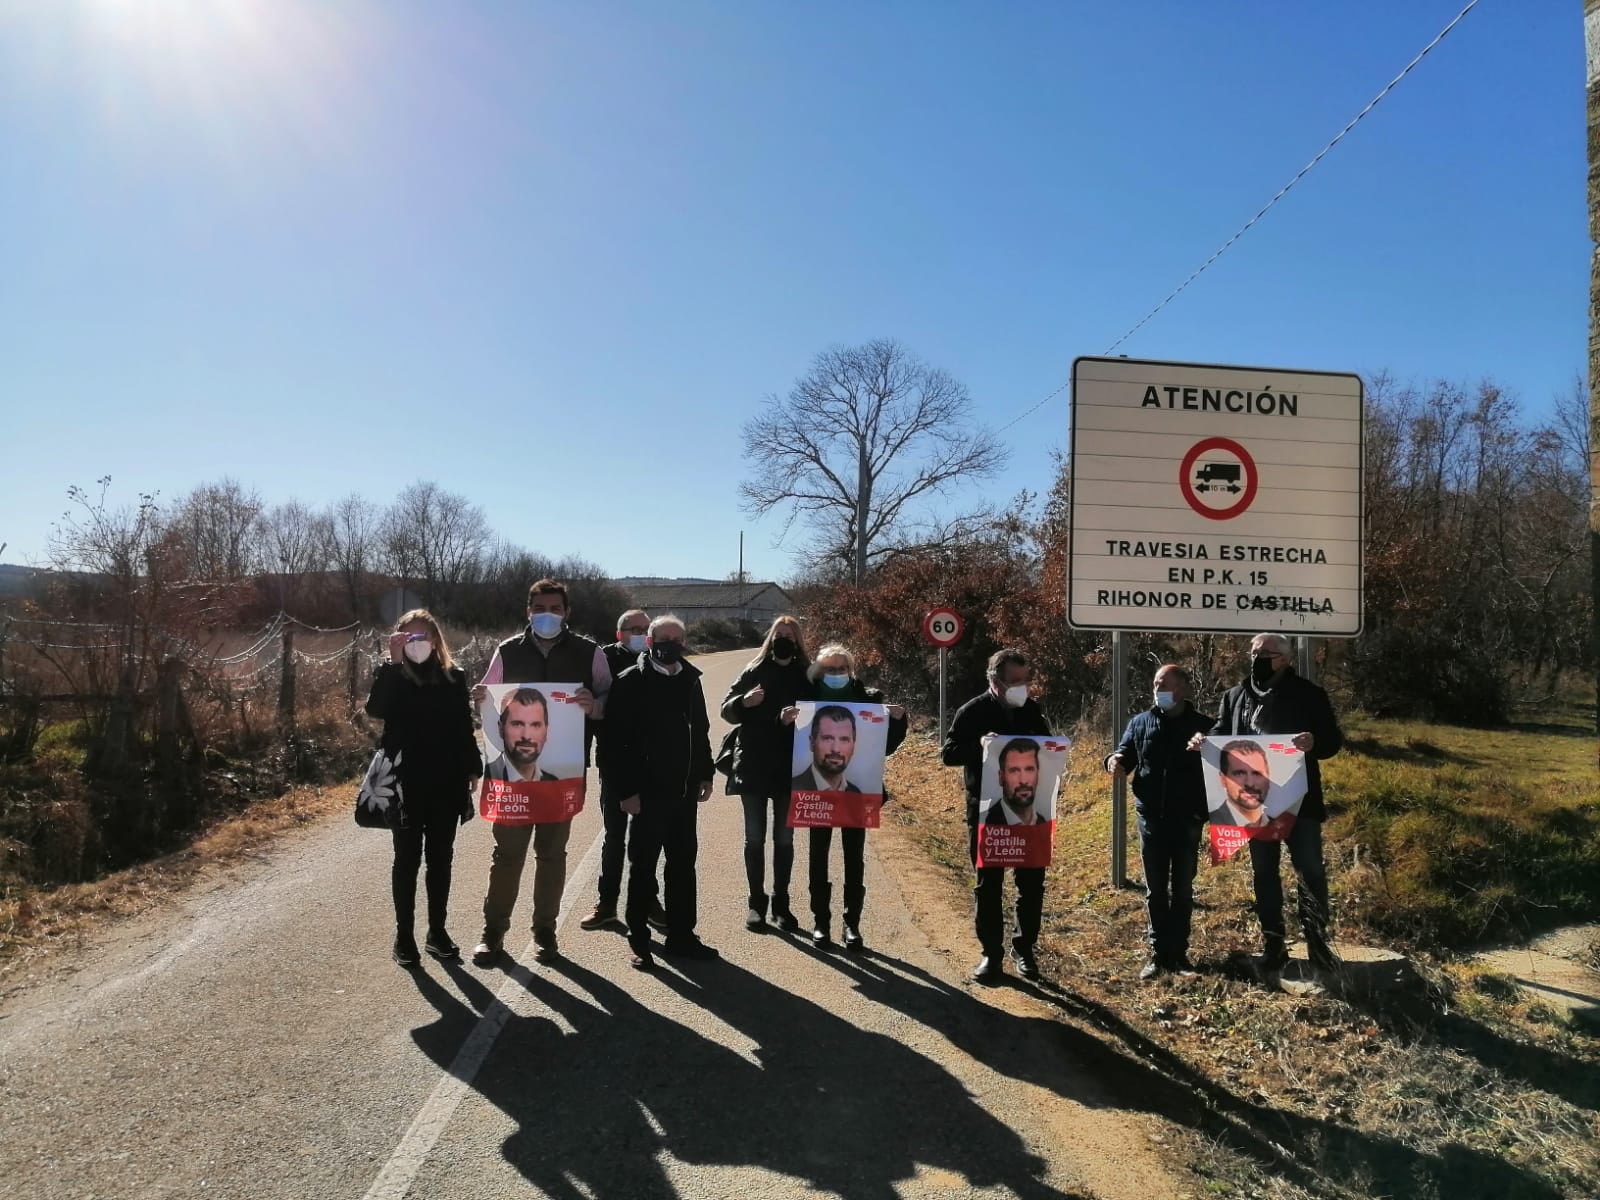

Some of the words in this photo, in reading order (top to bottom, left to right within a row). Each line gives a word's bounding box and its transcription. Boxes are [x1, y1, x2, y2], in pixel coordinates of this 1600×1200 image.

[1141, 385, 1298, 416] ATENCIÓN
[1106, 540, 1209, 559] TRAVESIA
[1220, 545, 1327, 564] ESTRECHA
[1168, 567, 1195, 583] EN
[1204, 569, 1242, 585] P.K.
[1249, 571, 1268, 585] 15
[1098, 590, 1192, 608] RIHONOR
[1201, 593, 1227, 608] DE
[1236, 595, 1334, 613] CASTILLA
[933, 620, 955, 634] 60
[488, 781, 512, 793] Vota
[487, 793, 529, 803] Castilla
[797, 792, 821, 801] Vota
[488, 804, 494, 814] y
[497, 803, 530, 813] León.
[795, 801, 834, 811] Castilla
[795, 810, 801, 819] y
[803, 809, 832, 820] León.
[985, 826, 1011, 836] Vota
[1216, 827, 1241, 837] Vota
[984, 836, 1026, 847] Castilla
[985, 848, 992, 857] y
[994, 846, 1026, 856] León.
[1218, 849, 1224, 858] y
